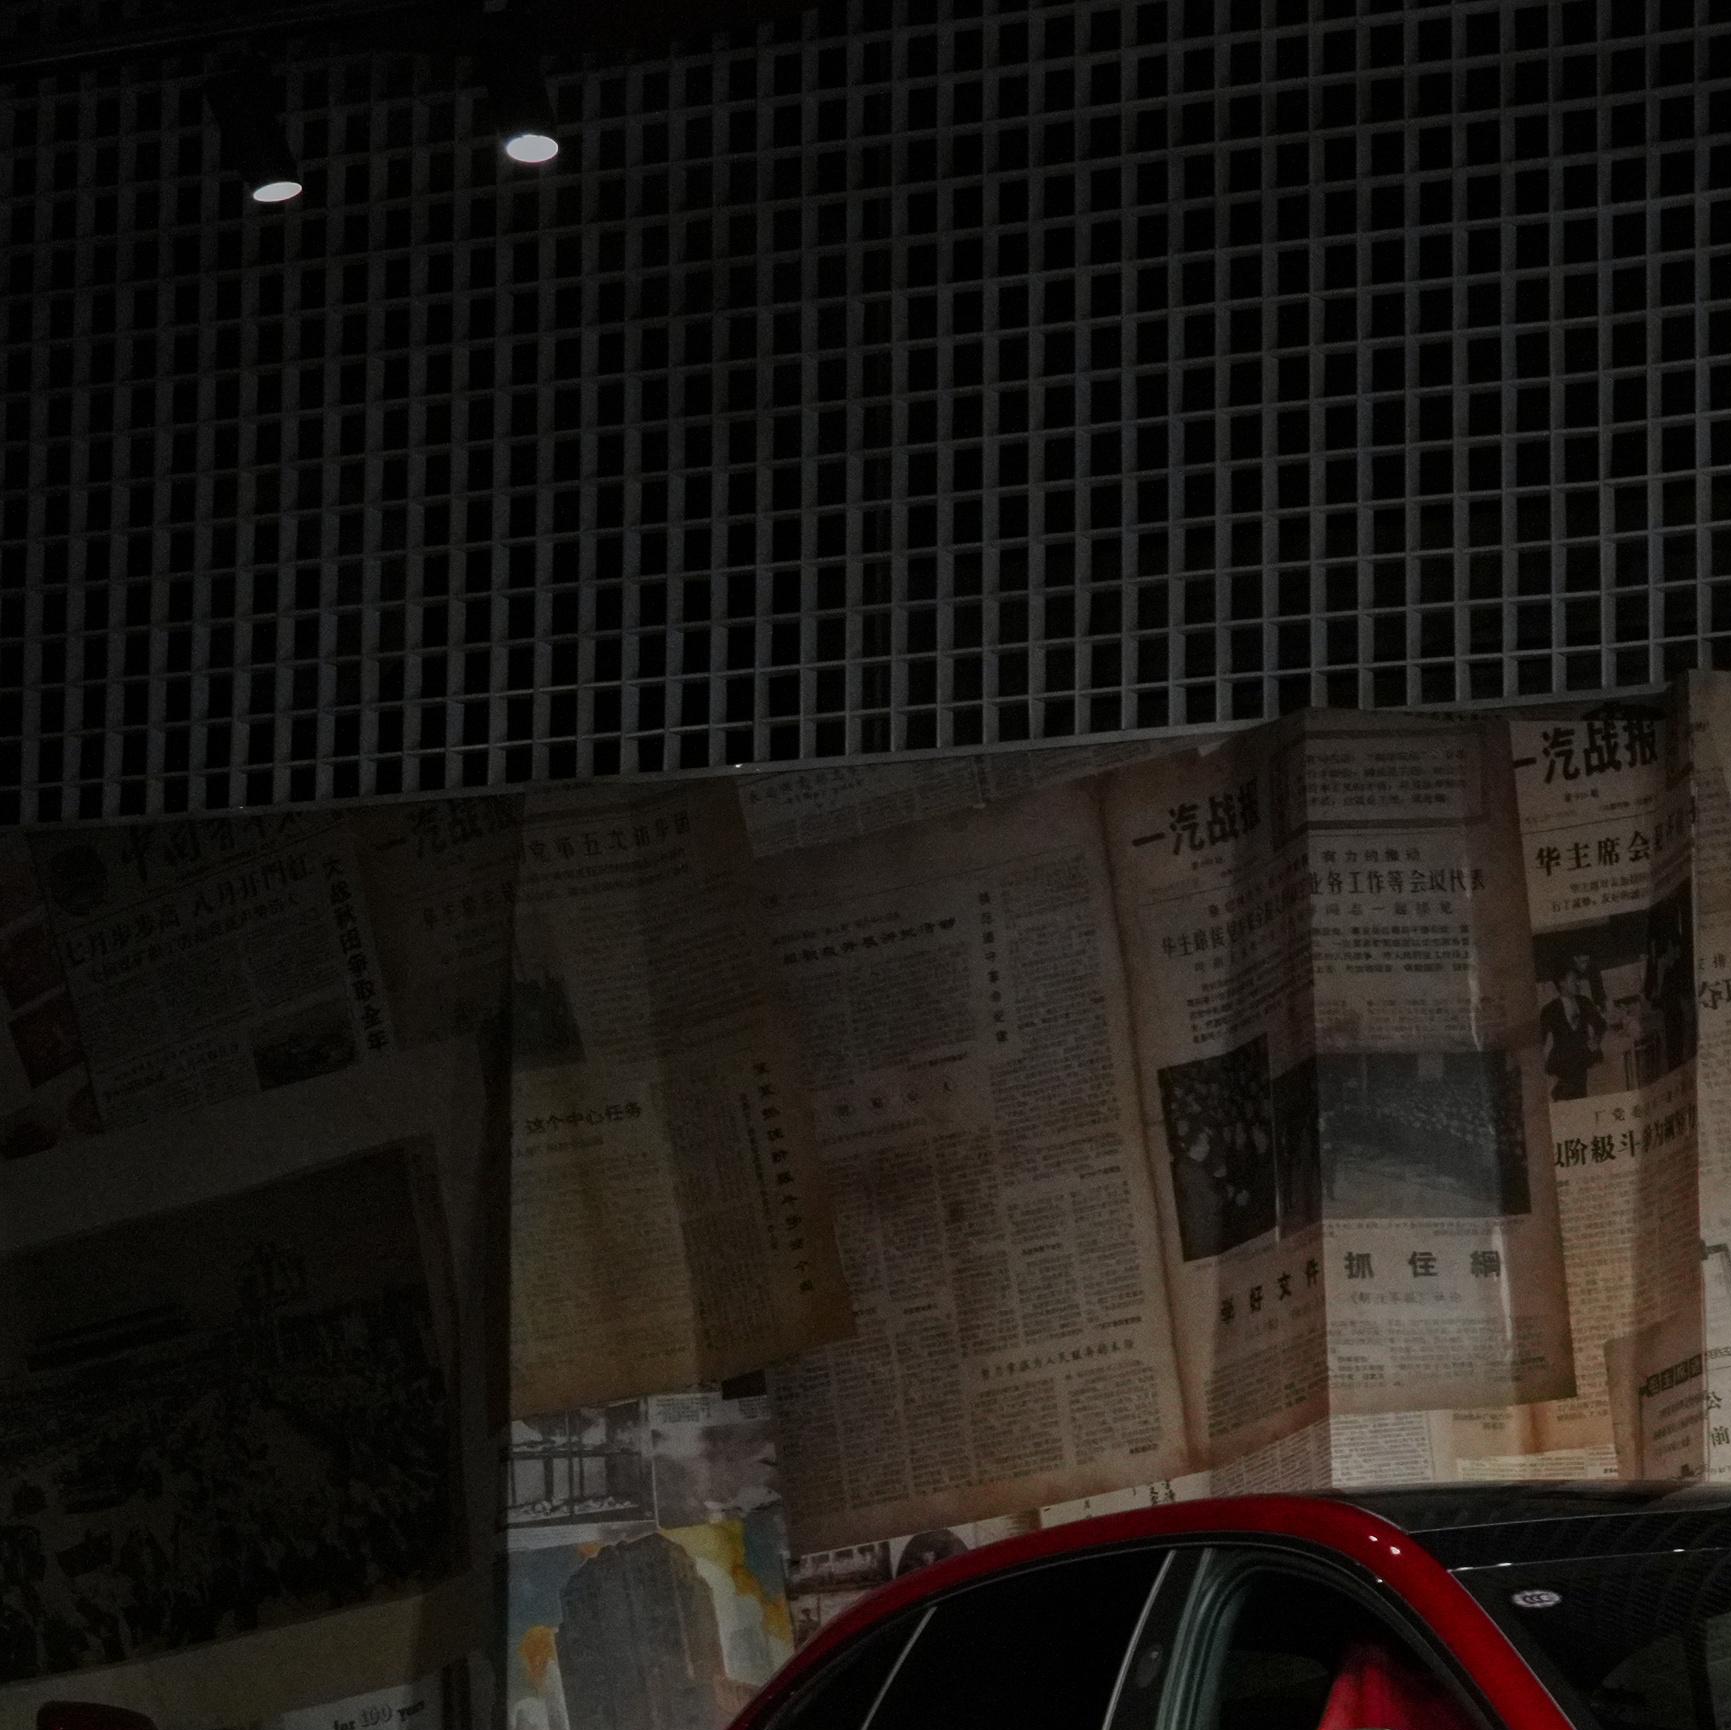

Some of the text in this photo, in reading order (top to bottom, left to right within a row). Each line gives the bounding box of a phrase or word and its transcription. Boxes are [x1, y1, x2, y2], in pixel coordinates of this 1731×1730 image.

[1512, 718, 1658, 785] 一汽战报
[359, 1703, 393, 1728] 100
